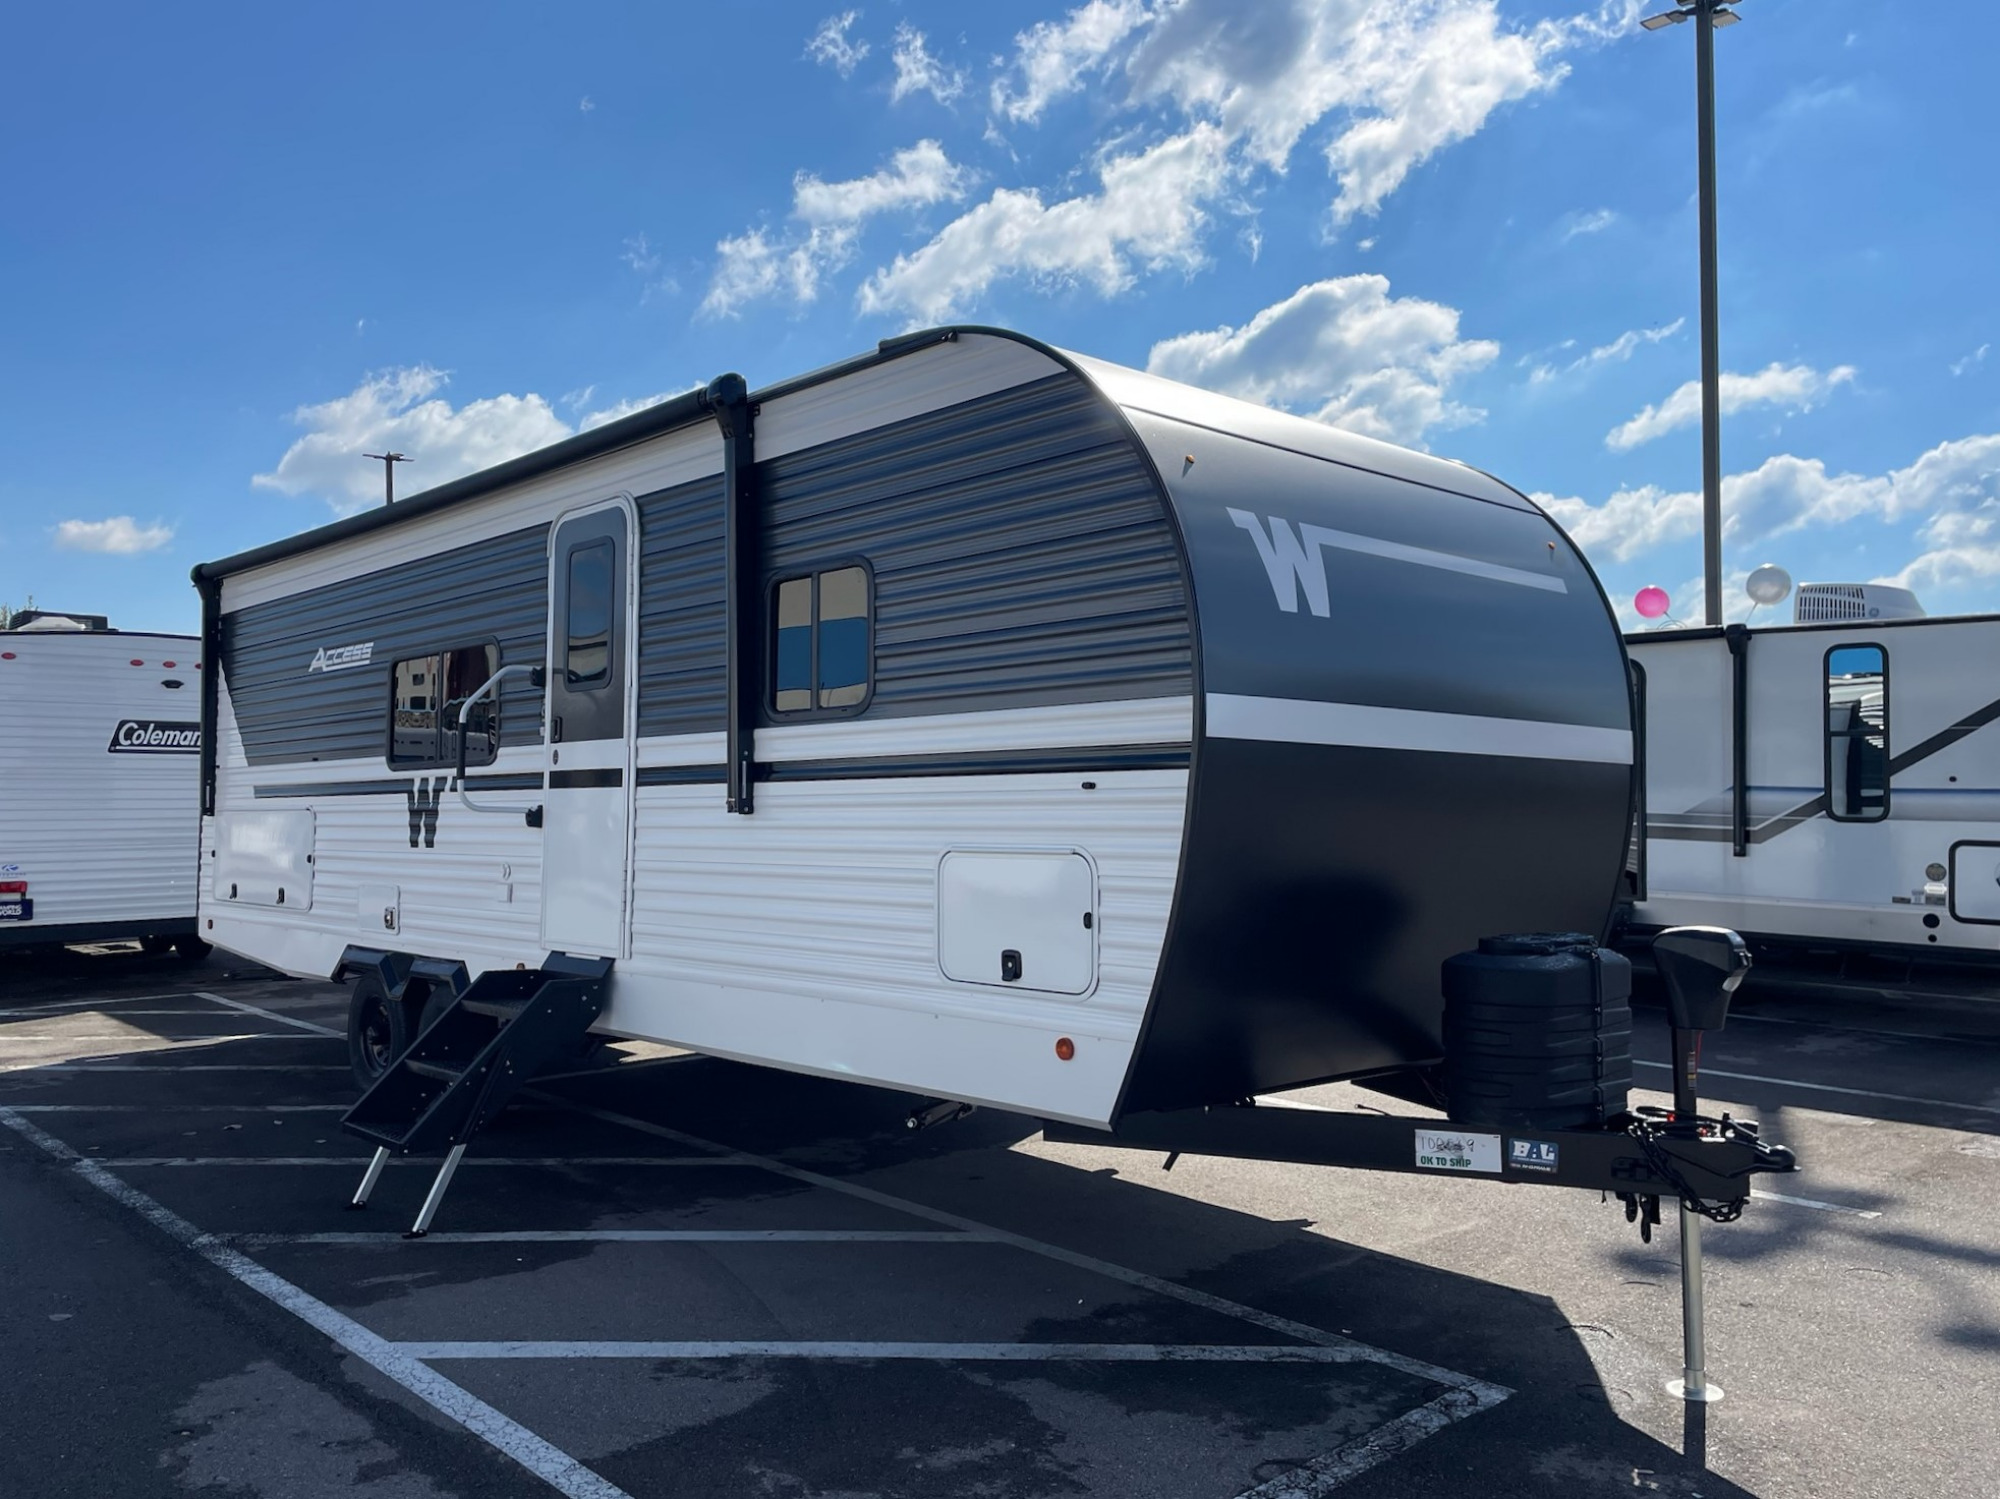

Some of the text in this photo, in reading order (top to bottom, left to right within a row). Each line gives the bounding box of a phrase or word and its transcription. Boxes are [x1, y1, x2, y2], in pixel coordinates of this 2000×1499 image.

[308, 642, 374, 672] ACCESS
[118, 722, 201, 746] Coleman
[1512, 1141, 1556, 1160] BAL
[1420, 1155, 1472, 1168] OK TO SHIP
